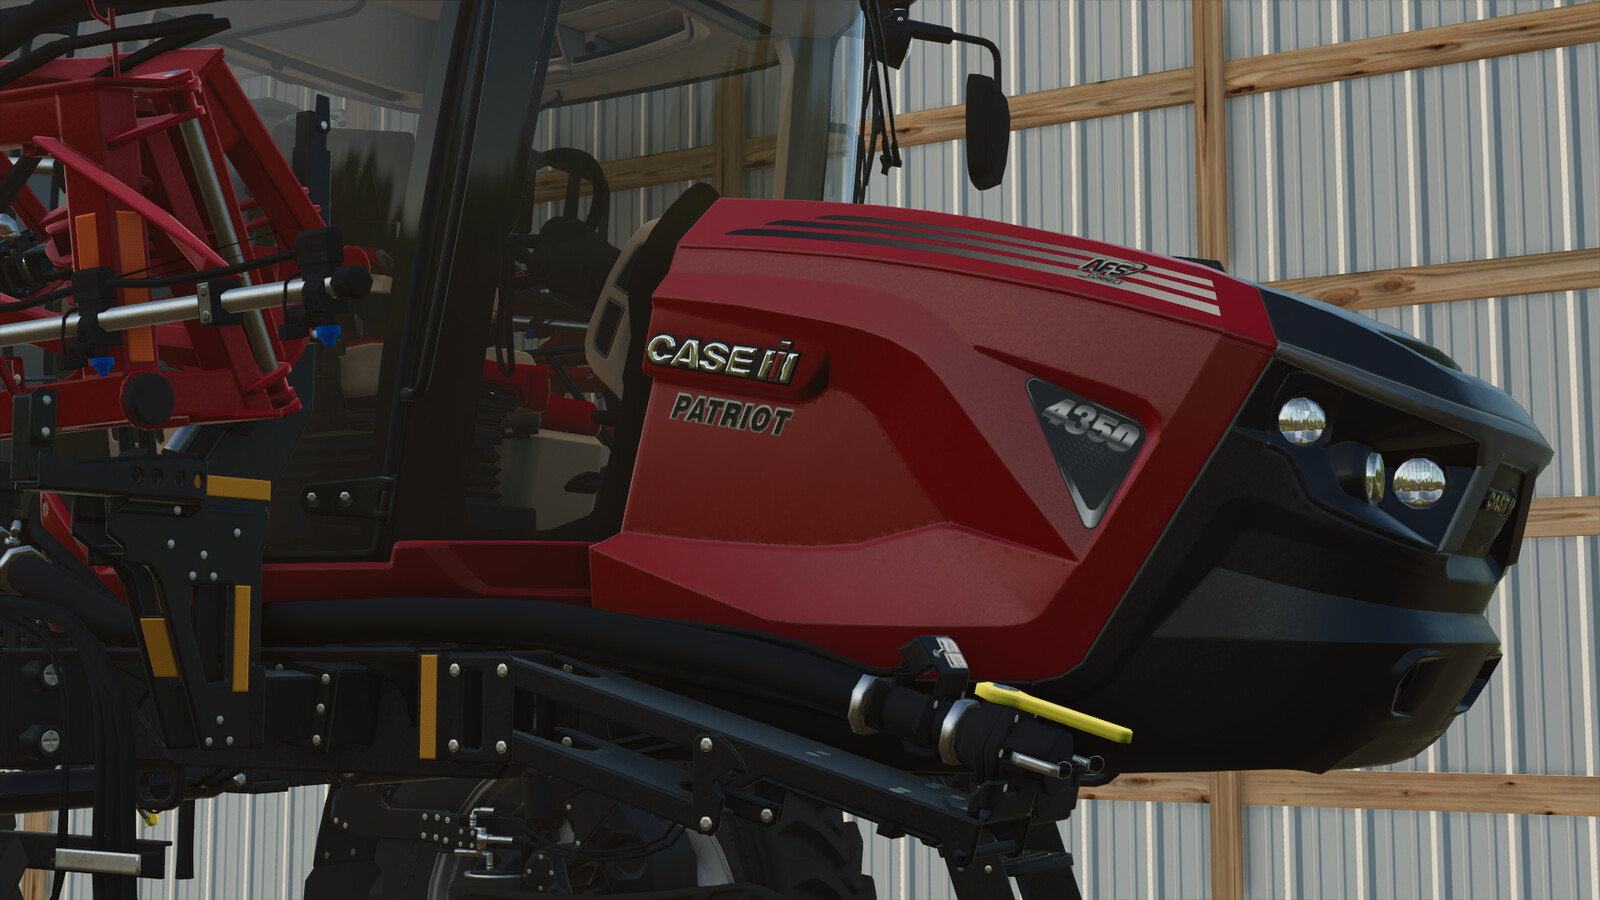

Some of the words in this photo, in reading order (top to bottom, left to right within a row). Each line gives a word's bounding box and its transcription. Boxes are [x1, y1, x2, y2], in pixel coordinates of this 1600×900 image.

[1078, 258, 1134, 276] AFS
[1087, 273, 1124, 285] CONNECT
[647, 334, 757, 375] CASE
[669, 392, 795, 436] PATRIOT
[1042, 399, 1140, 452] 4350
